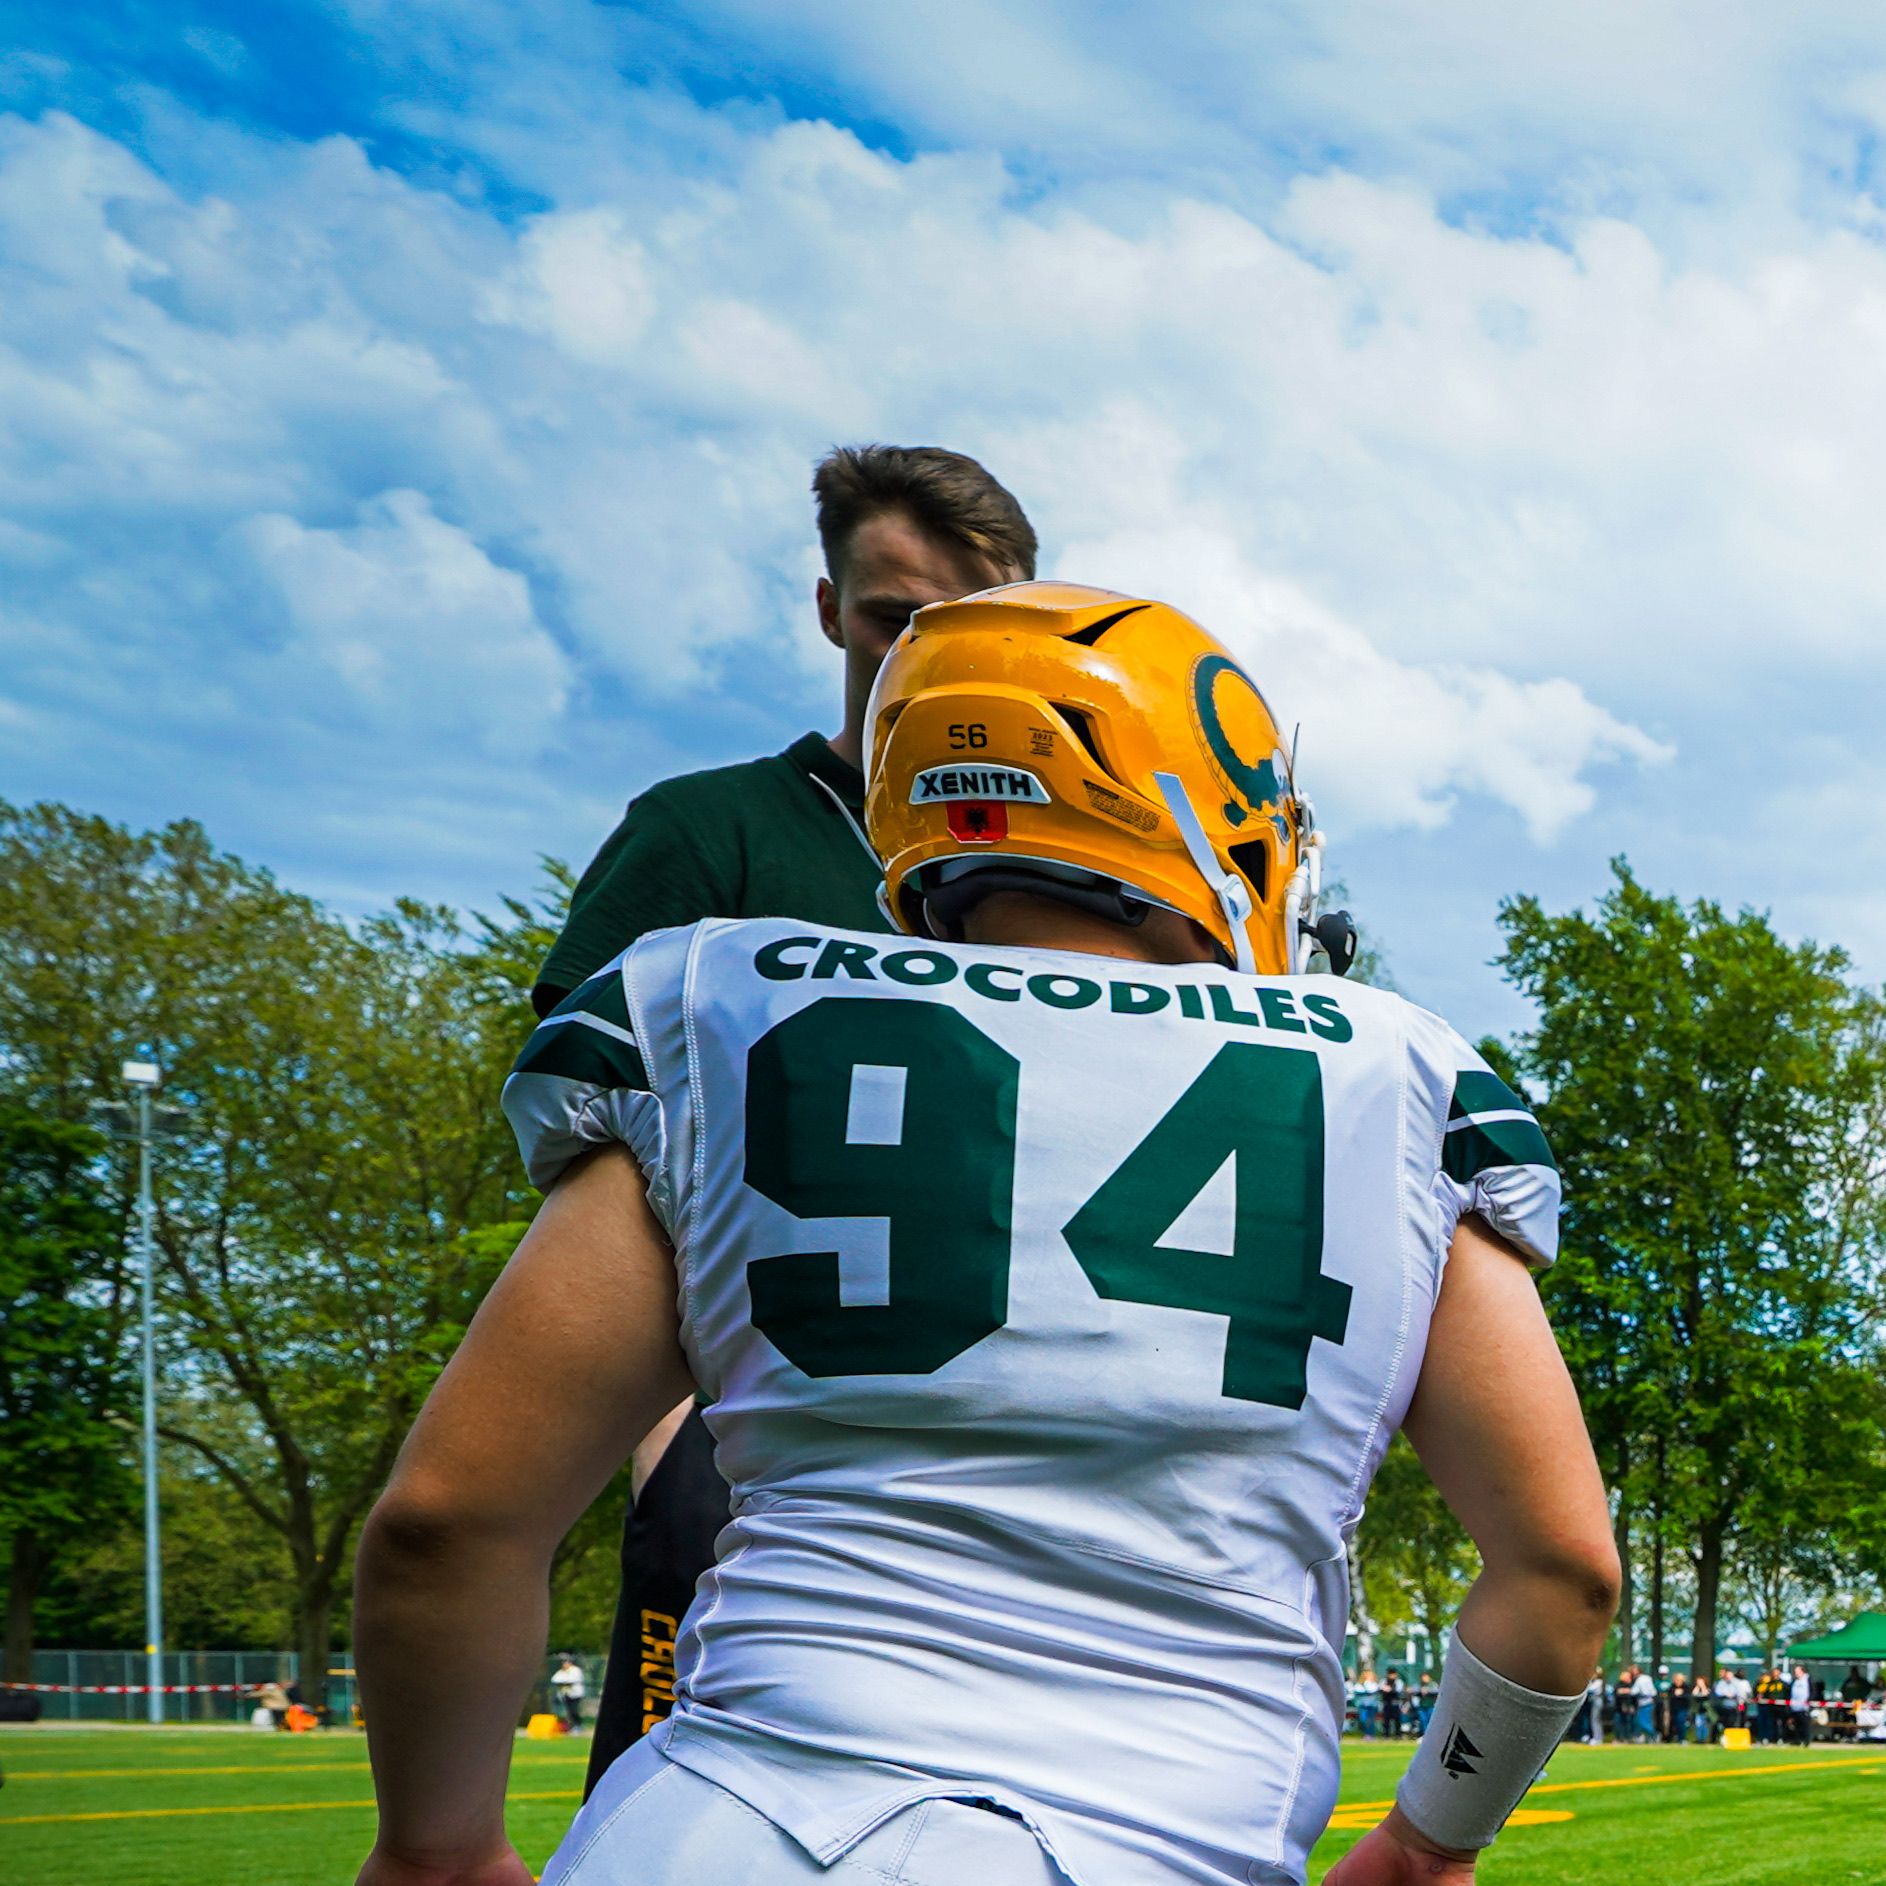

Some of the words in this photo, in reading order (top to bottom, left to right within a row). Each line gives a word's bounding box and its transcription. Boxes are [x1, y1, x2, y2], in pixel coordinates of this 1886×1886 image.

[947, 723, 988, 750] 56
[918, 772, 1032, 798] XENITH
[753, 936, 1354, 1043] CROCODILES
[742, 996, 1355, 1411] 94
